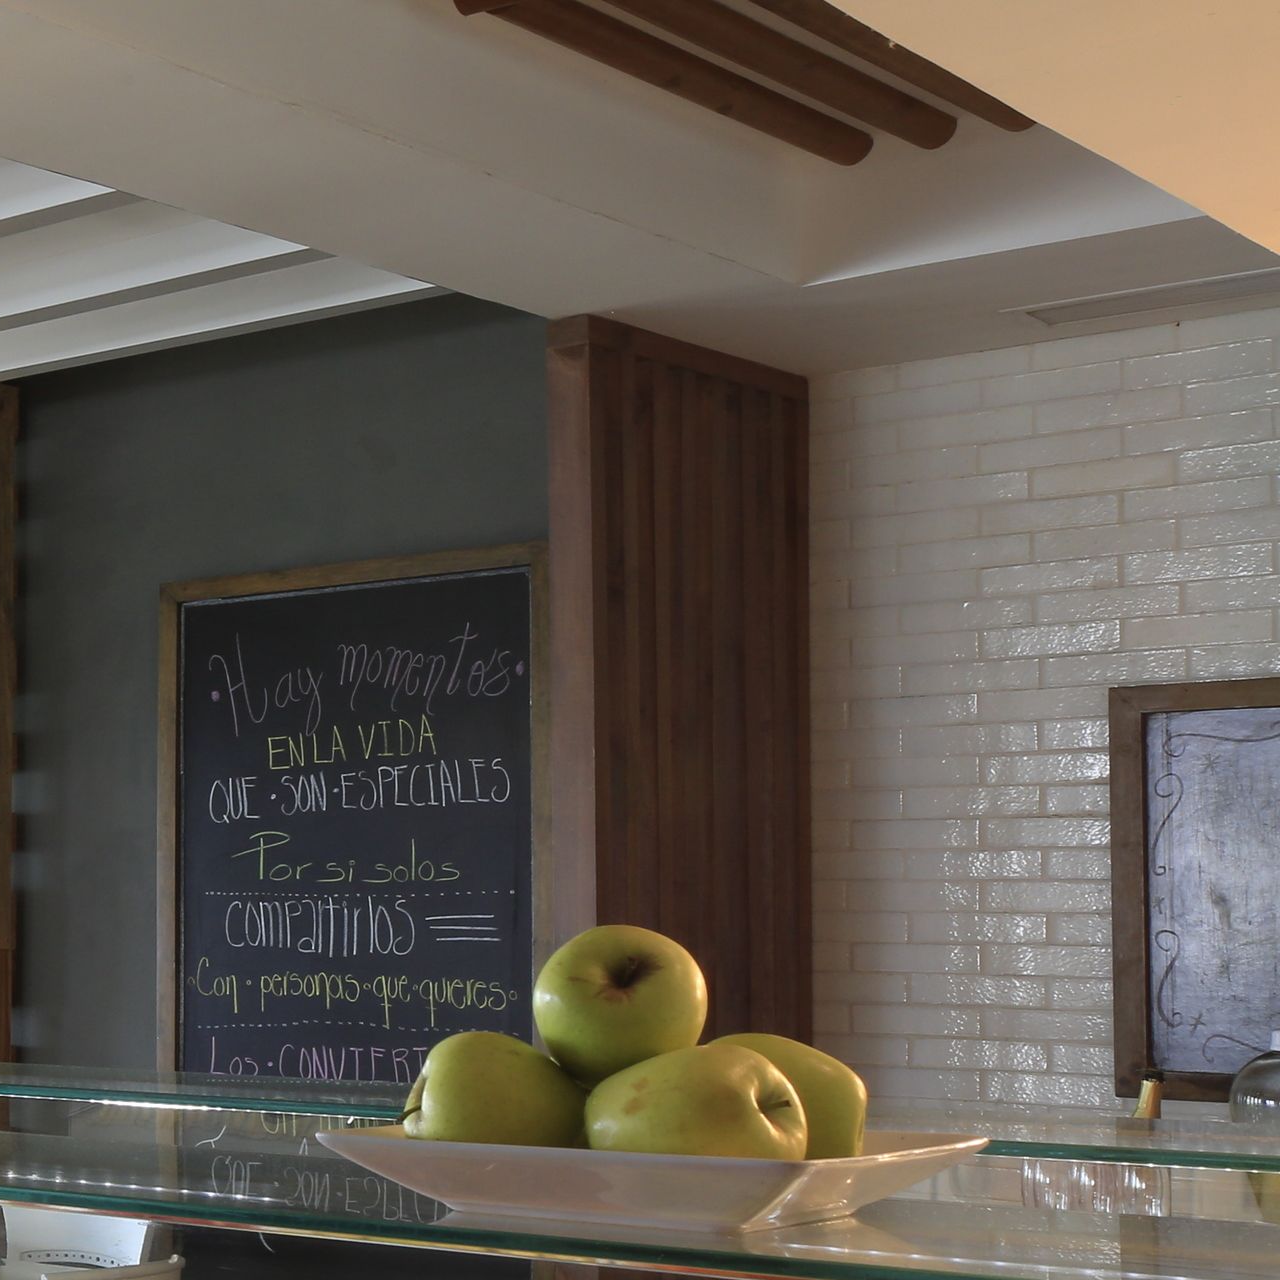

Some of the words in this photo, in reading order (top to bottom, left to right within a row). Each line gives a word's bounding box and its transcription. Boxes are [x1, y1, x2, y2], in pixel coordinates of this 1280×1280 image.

[209, 632, 323, 737] Hay
[268, 733, 305, 770] EN
[313, 726, 346, 763] LA
[359, 714, 436, 759] VIDA
[209, 776, 260, 824] QUE
[281, 772, 326, 816] SON
[340, 758, 510, 811] ESPECIALES
[232, 832, 312, 881] Por
[363, 838, 460, 883] solos
[196, 957, 239, 1014] Con
[260, 971, 360, 1012] personas
[373, 975, 411, 1030] que
[419, 975, 507, 1027] quieres
[210, 1036, 259, 1076] Los
